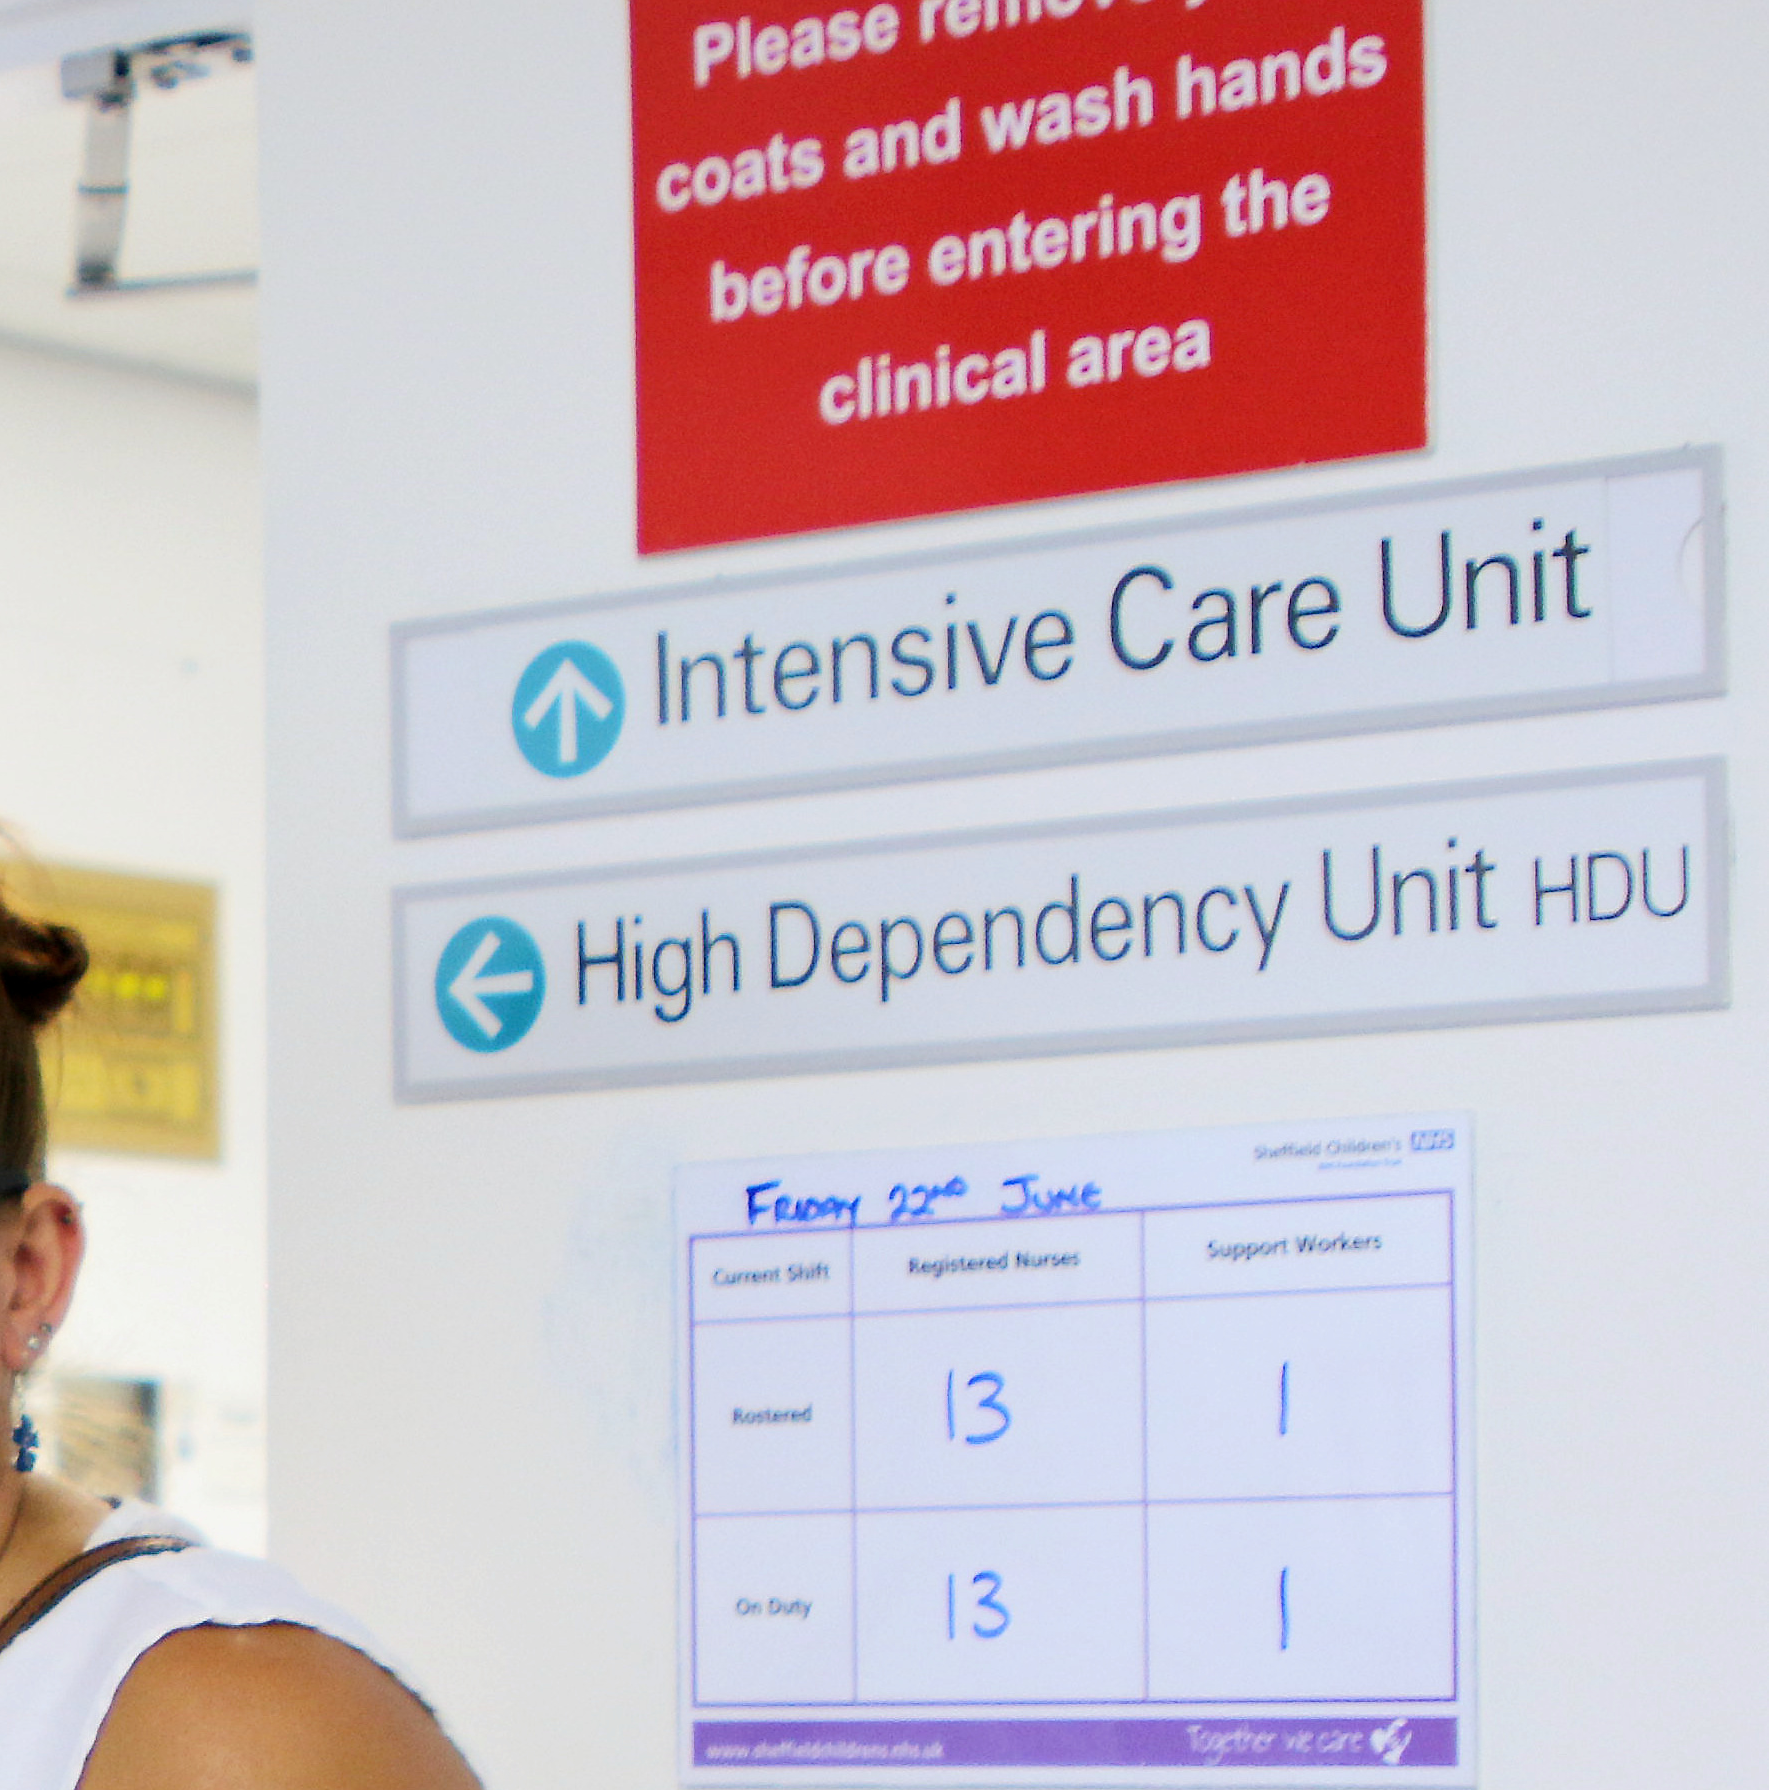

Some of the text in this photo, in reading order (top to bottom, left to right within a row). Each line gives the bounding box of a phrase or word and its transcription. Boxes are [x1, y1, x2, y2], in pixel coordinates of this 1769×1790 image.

[692, 2, 901, 89] Please
[656, 24, 1389, 214] coats and wash hands
[709, 166, 1333, 322] before entering the
[817, 316, 1213, 426] clinical area
[653, 516, 1595, 728] Intensive Care Unit
[573, 838, 1694, 1024] High Dependency Unit HDU
[713, 1262, 830, 1286] Current Shift
[907, 1249, 1081, 1277] Registered Nurses
[1207, 1231, 1384, 1260] Support Workers
[731, 1405, 813, 1425] Rostered
[946, 1368, 1013, 1446] 13
[735, 1597, 813, 1619] On Duty
[947, 1570, 1013, 1640] 13
